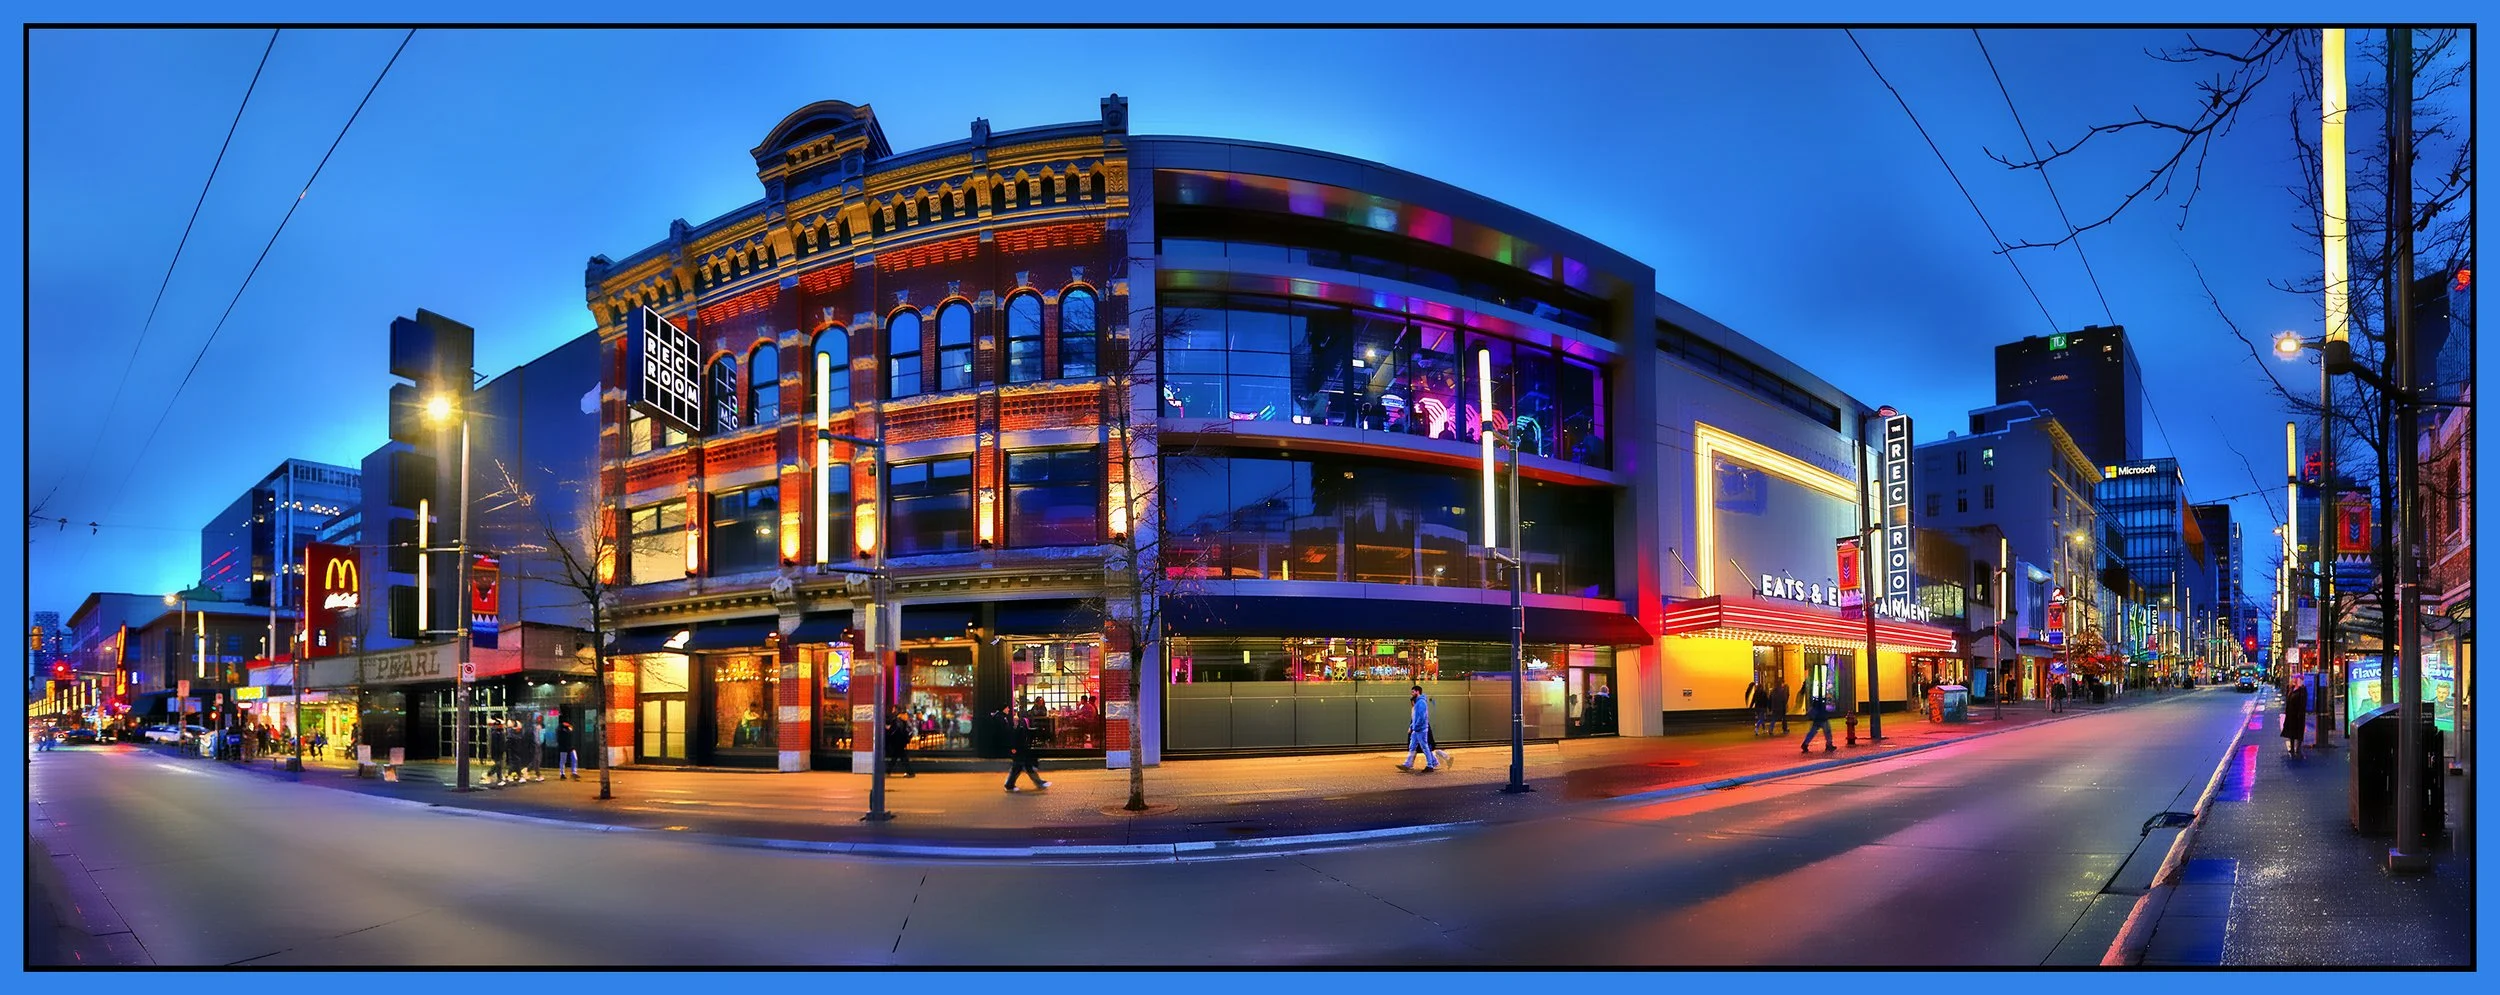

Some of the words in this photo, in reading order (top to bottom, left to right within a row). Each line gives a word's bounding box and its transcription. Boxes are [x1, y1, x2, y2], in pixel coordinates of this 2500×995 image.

[647, 337, 684, 373] REC
[2051, 336, 2066, 348] TD
[647, 360, 698, 404] ROOM
[1891, 443, 1903, 501] REC
[2118, 463, 2156, 477] Microsoft
[1760, 574, 1805, 601] EATS
[1810, 583, 1823, 604] &
[376, 650, 440, 680] PEARL
